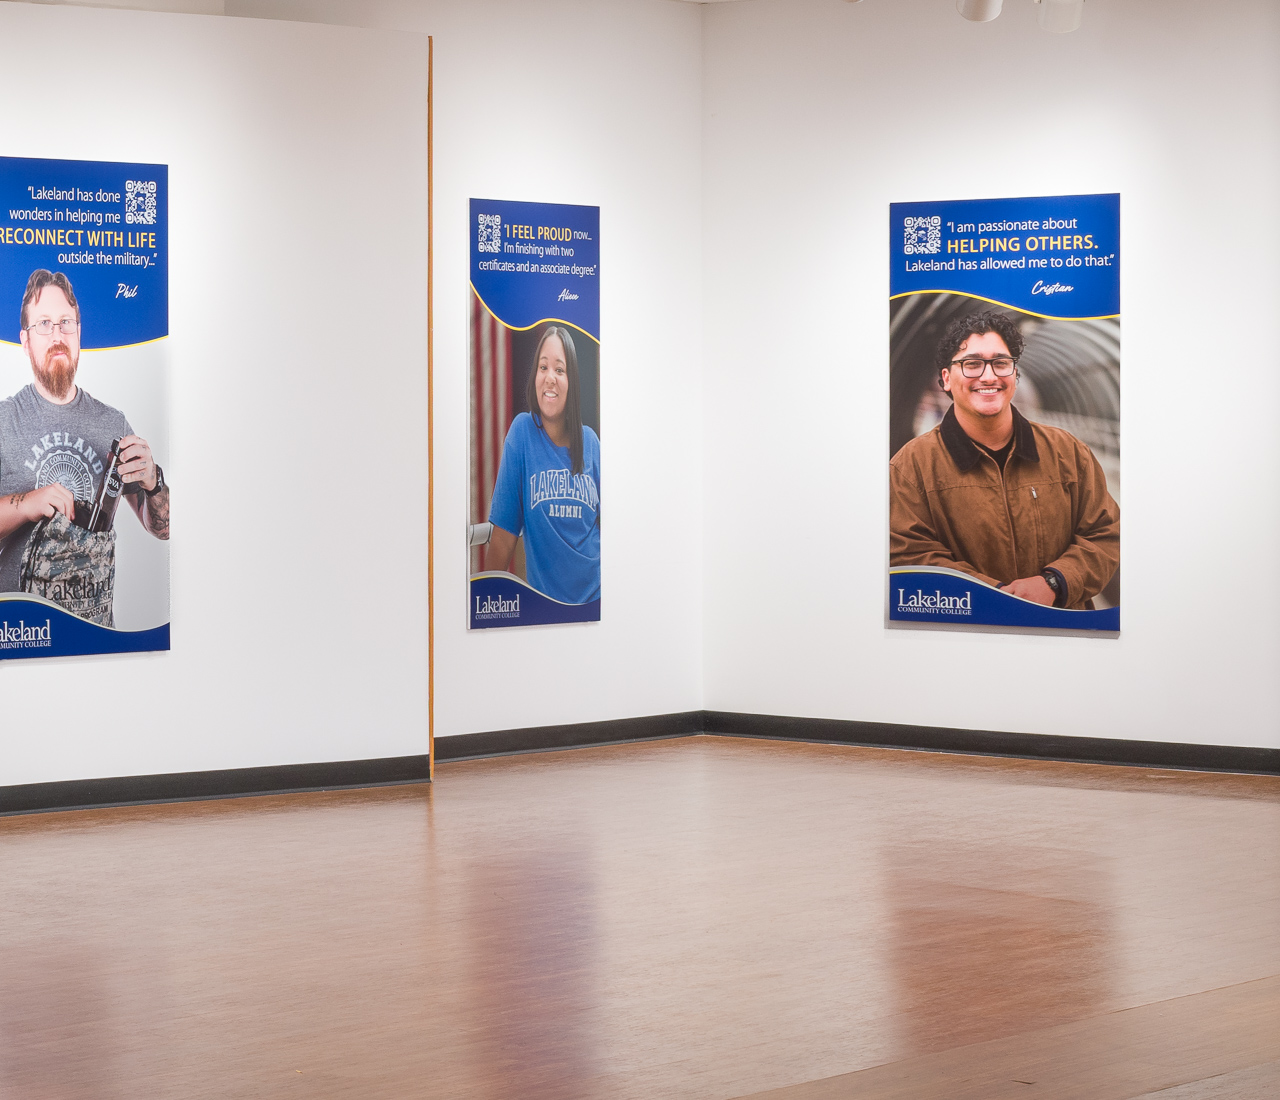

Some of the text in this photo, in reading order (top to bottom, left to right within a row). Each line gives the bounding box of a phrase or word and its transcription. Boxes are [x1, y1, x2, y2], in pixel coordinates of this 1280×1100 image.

[77, 188, 93, 201] has
[95, 189, 120, 203] done
[9, 207, 120, 226] wonders in helping me
[512, 225, 535, 239] FEEL
[538, 226, 572, 241] PROUD
[957, 224, 975, 232] am
[978, 220, 1039, 234] passionate
[1042, 217, 1077, 229] about
[87, 231, 123, 247] WITH
[128, 232, 156, 248] LIFE
[947, 235, 1098, 253] HELPING OTHERS.
[58, 251, 94, 264] outside
[96, 251, 112, 264] the
[515, 242, 543, 258] finishing
[545, 245, 560, 256] with
[561, 247, 574, 256] two
[479, 259, 515, 271] certificates
[516, 261, 529, 272] and
[531, 264, 539, 272] an
[540, 263, 570, 274] associate
[906, 259, 955, 272] Lakeland
[958, 258, 977, 270] has
[980, 257, 1025, 270] allowed
[1029, 259, 1047, 268] me
[1050, 258, 1063, 267] to
[1066, 255, 1082, 267] do
[116, 283, 138, 298] Phil
[1032, 280, 1073, 295] Cristian
[24, 432, 104, 475] LAKELAND
[549, 504, 582, 518] ALUMNI
[476, 594, 520, 614] Lakeland
[898, 588, 971, 609] Lakeland
